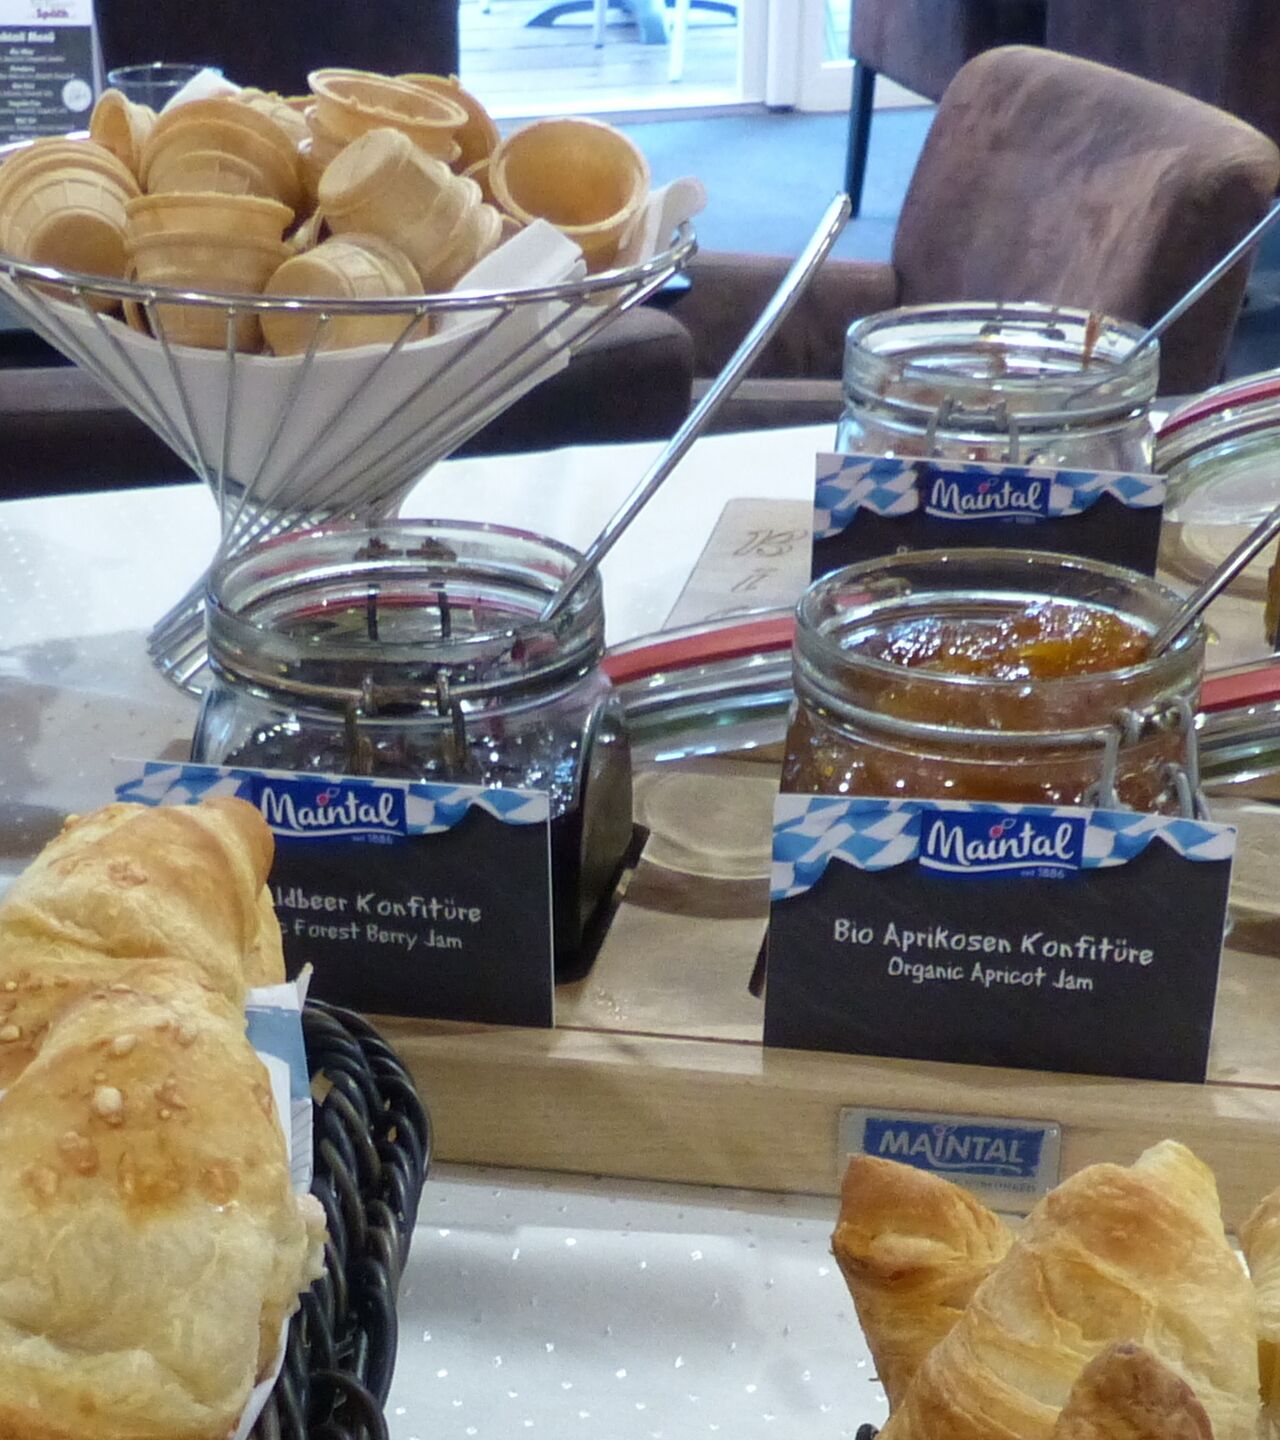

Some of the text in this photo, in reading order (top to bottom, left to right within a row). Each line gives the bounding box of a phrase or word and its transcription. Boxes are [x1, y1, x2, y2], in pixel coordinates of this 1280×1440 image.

[930, 478, 1043, 515] Maintal
[260, 786, 400, 831] Maintal
[926, 818, 1075, 865] Maintal
[273, 887, 482, 923] ldbeer Konfitüre
[294, 919, 360, 941] Forest
[366, 924, 418, 951] Berry
[424, 929, 463, 949] Jam
[833, 918, 1154, 965] Bio Aprikosen Konfitüre
[887, 956, 1094, 991] Organic Apricot Jam
[878, 1129, 1024, 1163] MAINTAL
